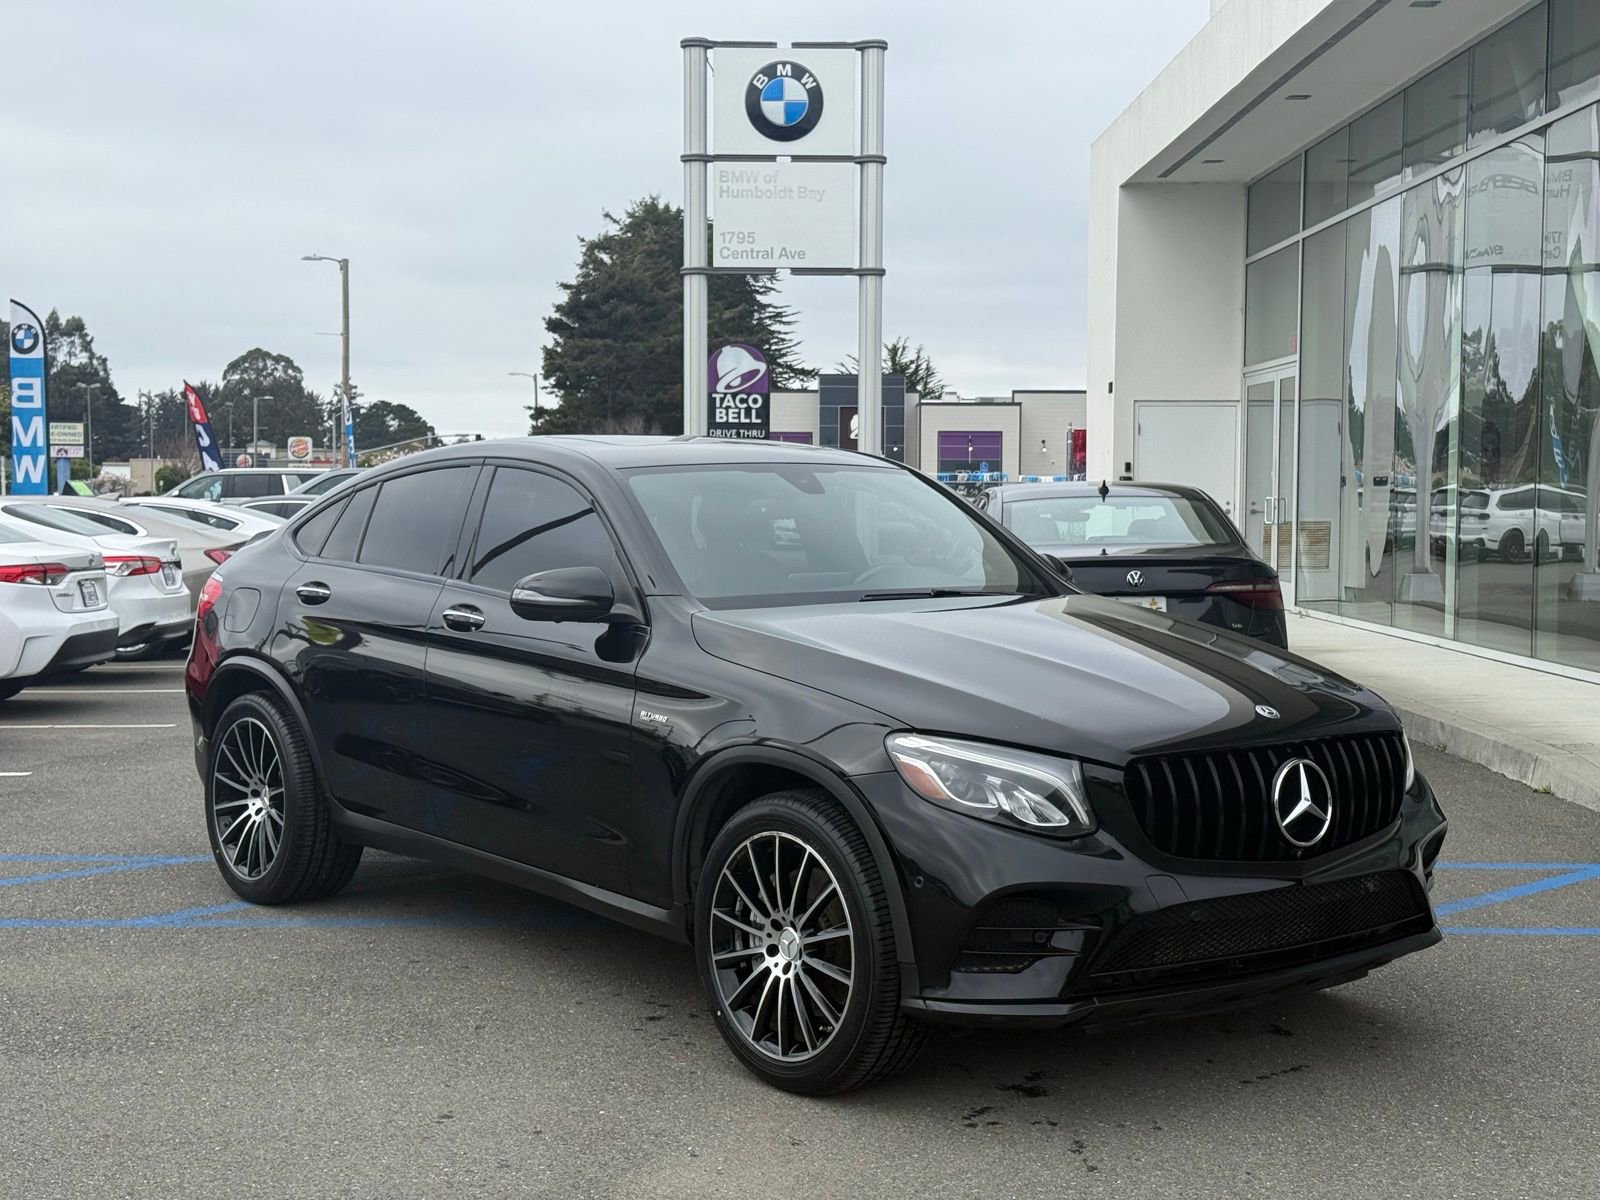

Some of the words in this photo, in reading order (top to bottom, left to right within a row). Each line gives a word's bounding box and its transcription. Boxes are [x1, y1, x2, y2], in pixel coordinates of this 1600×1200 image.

[752, 64, 817, 89] BMW
[719, 170, 760, 183] BMW
[763, 170, 779, 184] of
[719, 186, 794, 199] Humboldt
[797, 186, 826, 202] Bay
[720, 231, 756, 245] 1795
[719, 246, 774, 260] Central
[778, 246, 806, 260] Ave
[712, 393, 763, 409] TACO
[715, 408, 762, 423] BELL
[709, 429, 737, 438] DRIVE
[739, 429, 765, 438] THRU
